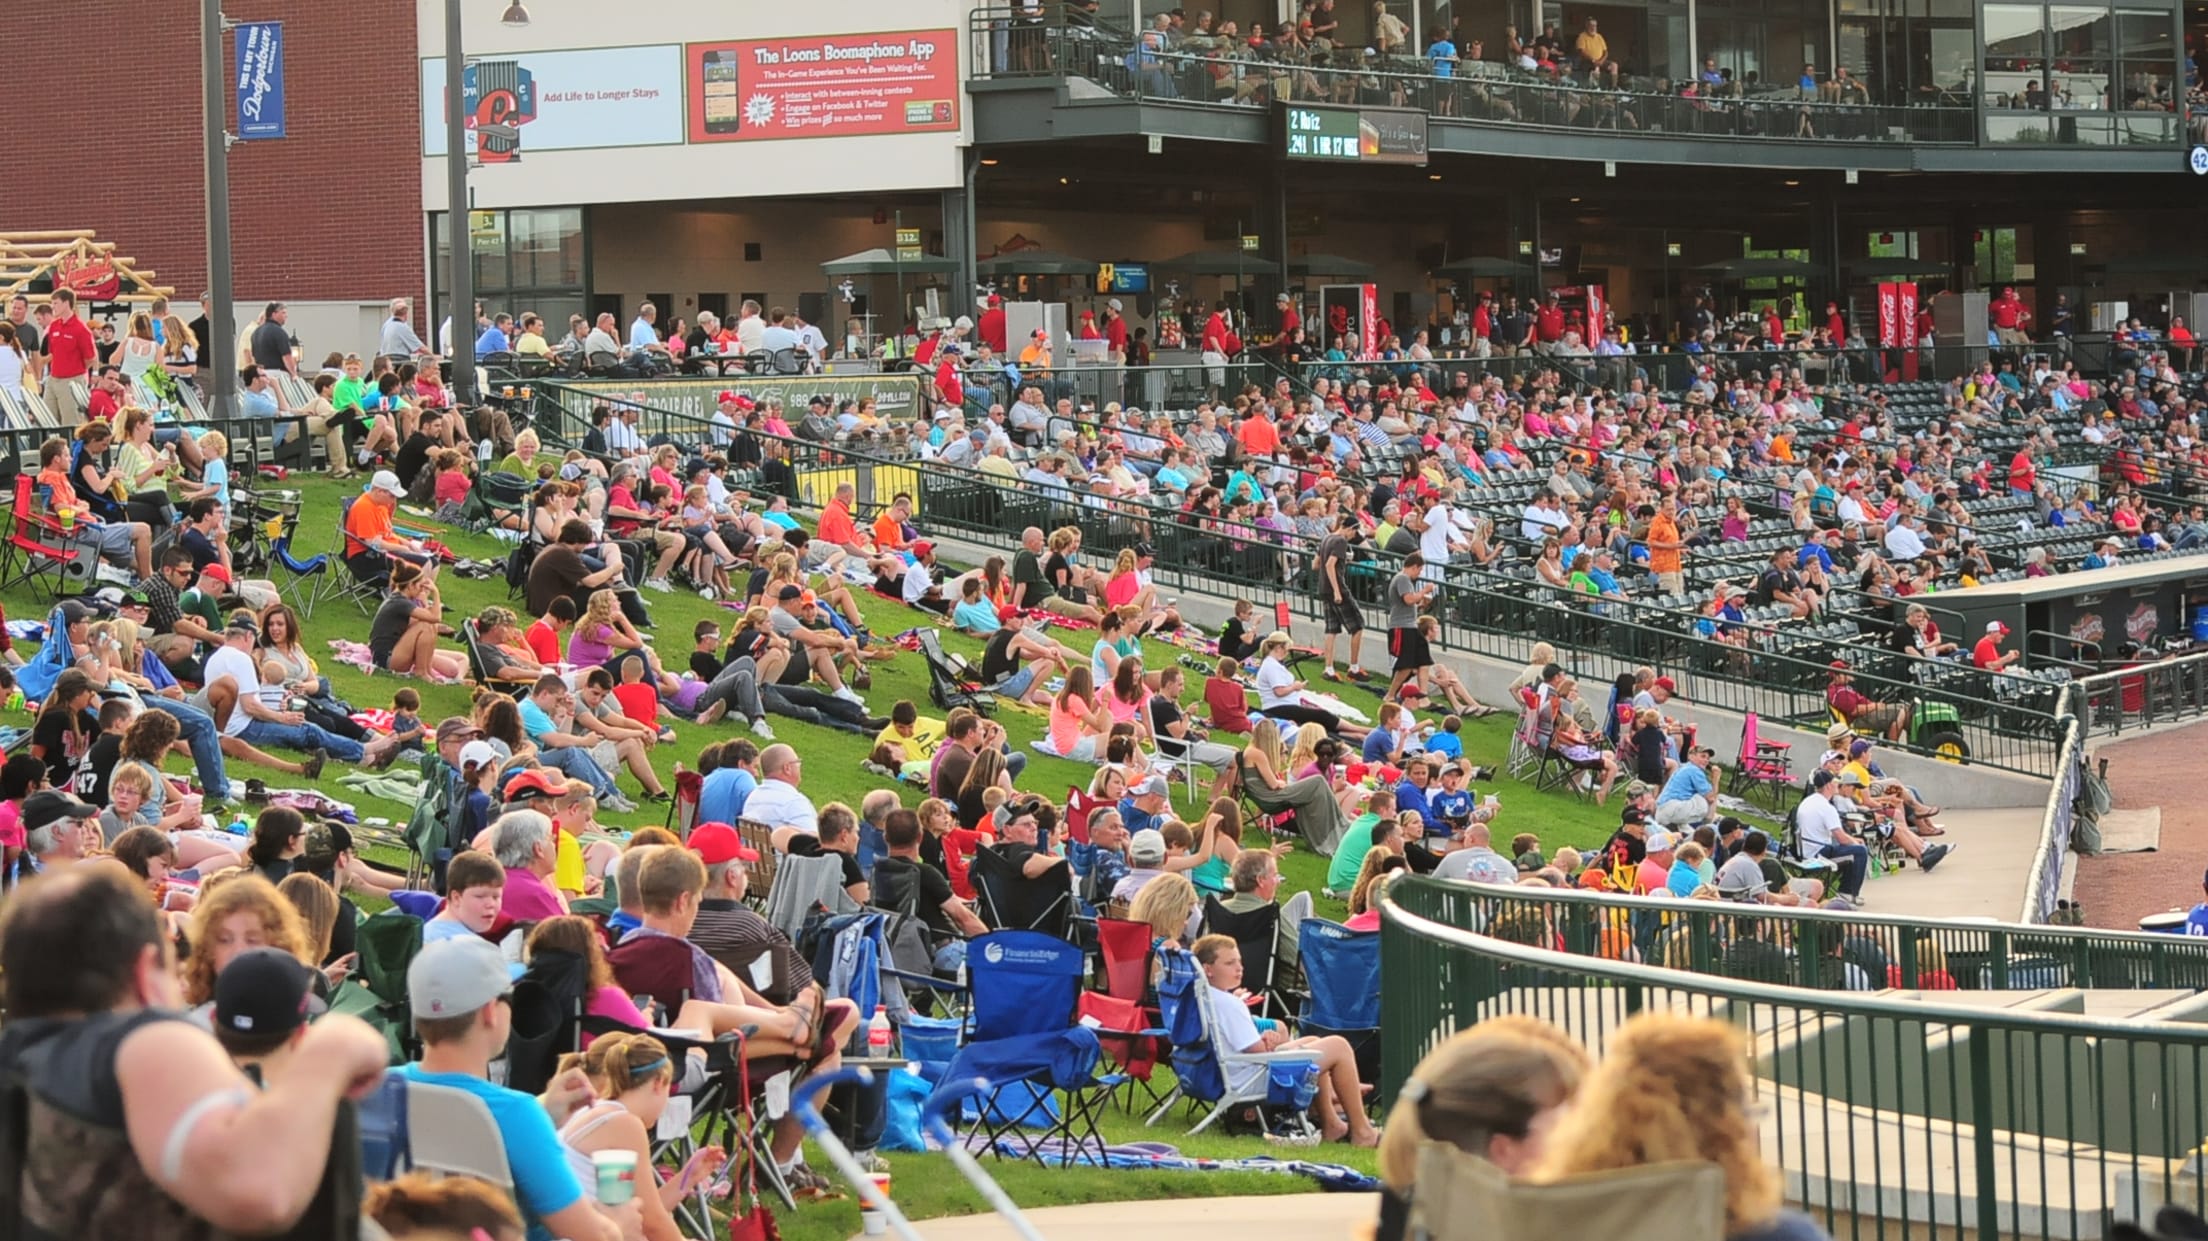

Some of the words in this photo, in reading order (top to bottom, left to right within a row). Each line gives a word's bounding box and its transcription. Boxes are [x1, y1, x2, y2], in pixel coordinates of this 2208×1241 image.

[754, 48, 779, 64] The
[783, 47, 820, 62] Loons
[824, 42, 904, 63] Boomaphone
[909, 40, 934, 60] App
[243, 25, 271, 121] Dodgertown
[764, 71, 776, 79] The
[778, 70, 807, 78] In-Game
[808, 68, 844, 78] Experience
[845, 66, 867, 75] You've
[869, 65, 886, 74] Been
[887, 64, 913, 74] Waiting
[544, 92, 562, 102] Add
[565, 91, 583, 101] Life
[585, 92, 595, 101] to
[597, 90, 630, 102] Longer
[632, 88, 660, 99] Stays
[813, 89, 829, 97] with
[785, 104, 811, 114] Engage
[822, 101, 855, 111] Facebook
[856, 101, 862, 109] &
[864, 100, 889, 109] Twitter
[1291, 110, 1298, 129] 2
[1300, 111, 1320, 130] Ruiz
[1313, 136, 1319, 154] 1
[2192, 153, 2208, 169] 42
